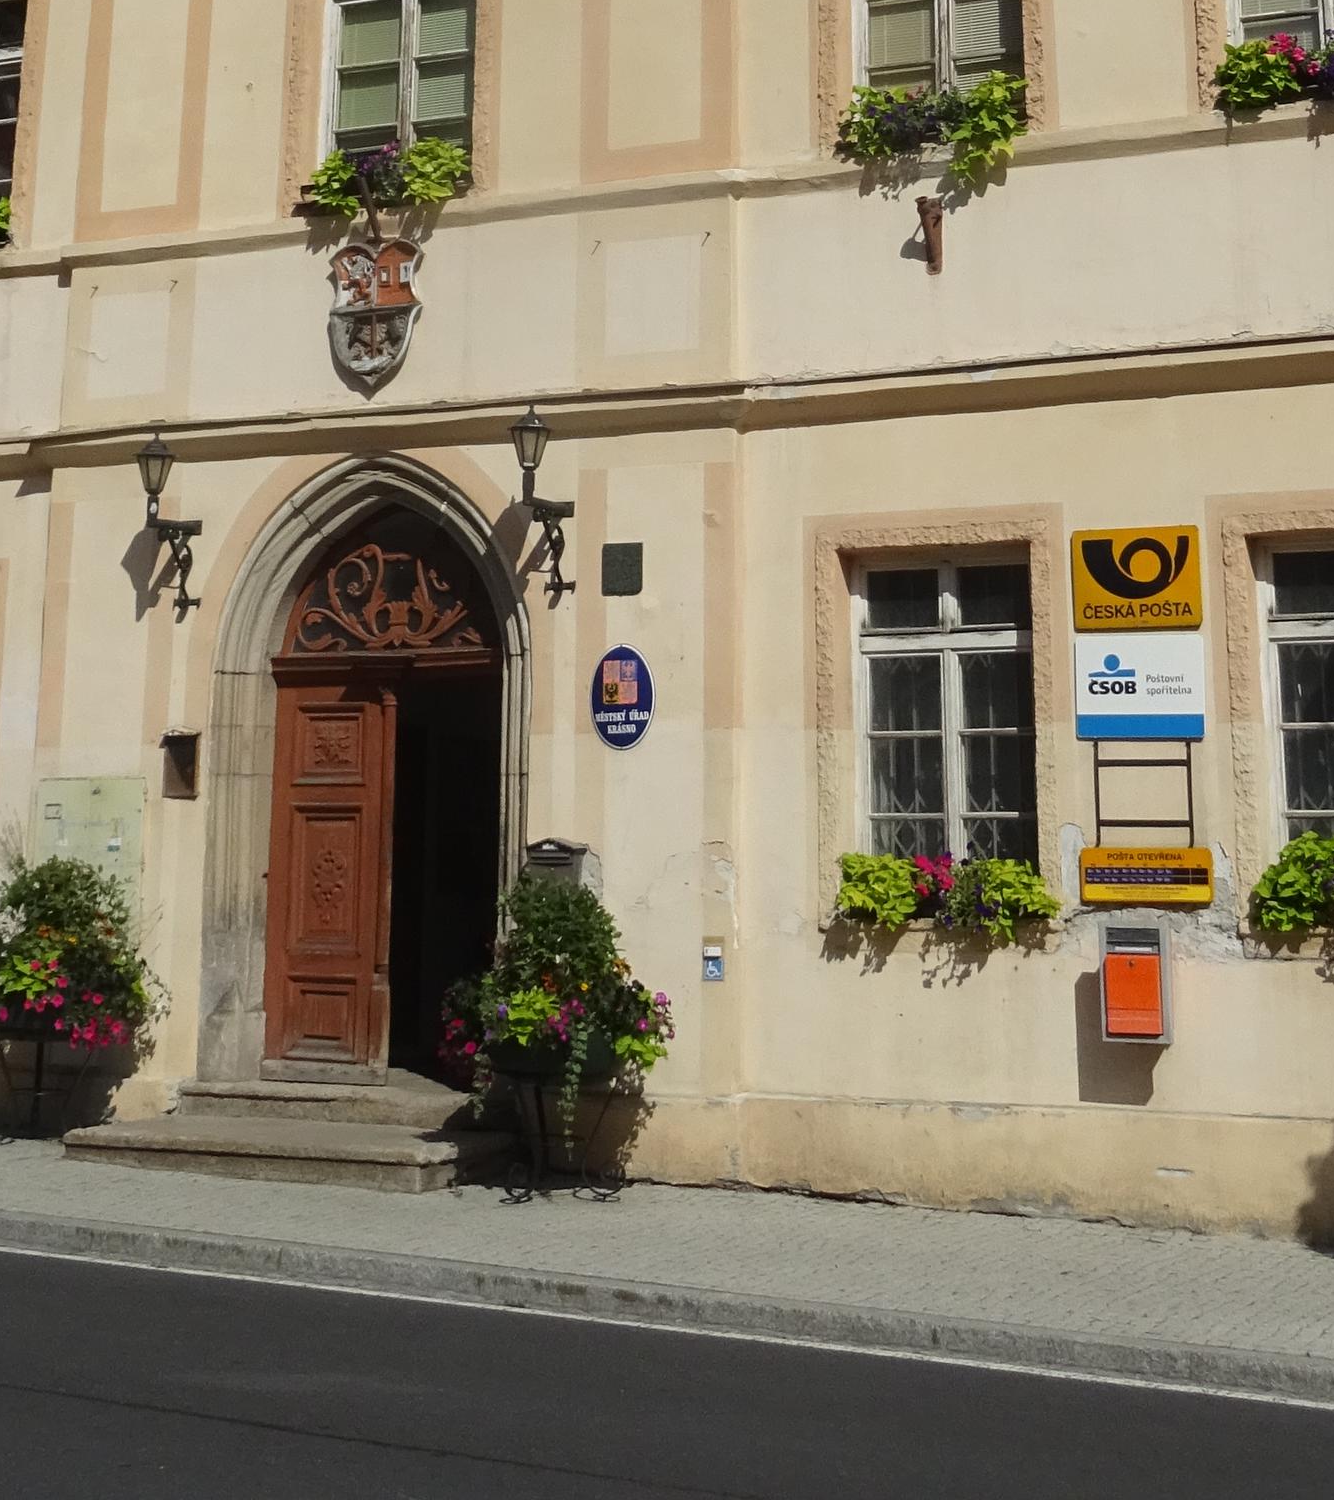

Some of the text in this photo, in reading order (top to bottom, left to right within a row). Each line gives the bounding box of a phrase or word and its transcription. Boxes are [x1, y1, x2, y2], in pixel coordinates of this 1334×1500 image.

[1082, 601, 1192, 620] ČESKÁ POŠTA
[1146, 673, 1185, 684] Poštovní
[1088, 678, 1137, 695] ČSOB
[1146, 685, 1193, 696] spořitelna
